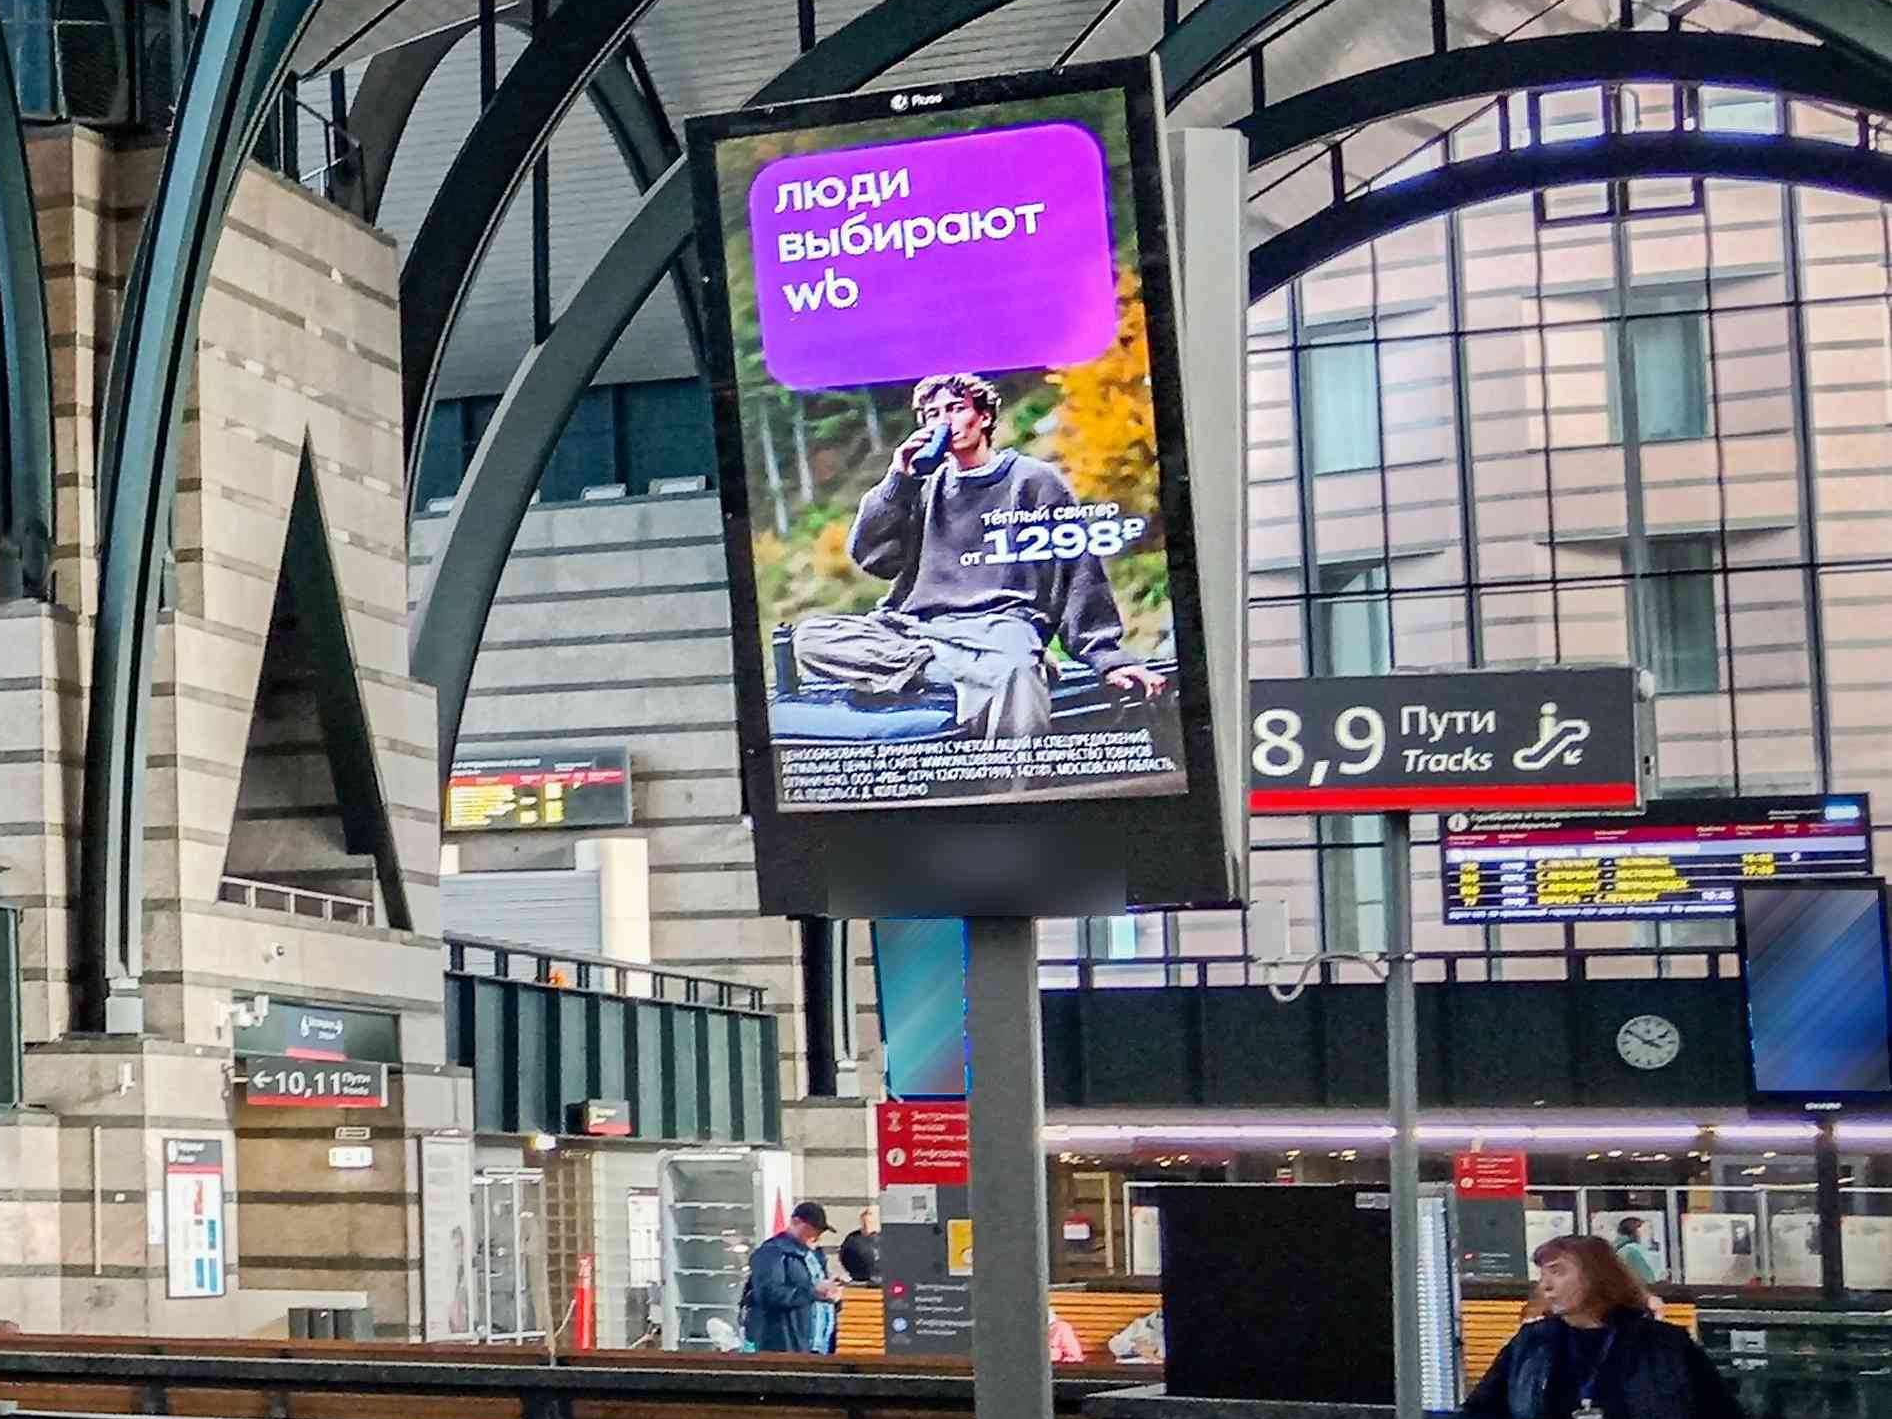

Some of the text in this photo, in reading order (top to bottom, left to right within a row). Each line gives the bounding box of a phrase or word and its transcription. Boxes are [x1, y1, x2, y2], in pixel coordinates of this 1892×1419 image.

[775, 167, 910, 213] люди
[778, 203, 1045, 262] выбирают
[782, 267, 858, 310] wb
[981, 502, 1119, 526] тёплый свитер
[960, 551, 982, 566] от
[1252, 705, 1497, 787] 8,9 Пути
[1401, 747, 1494, 773] Tracks
[275, 1070, 341, 1099] 10,11
